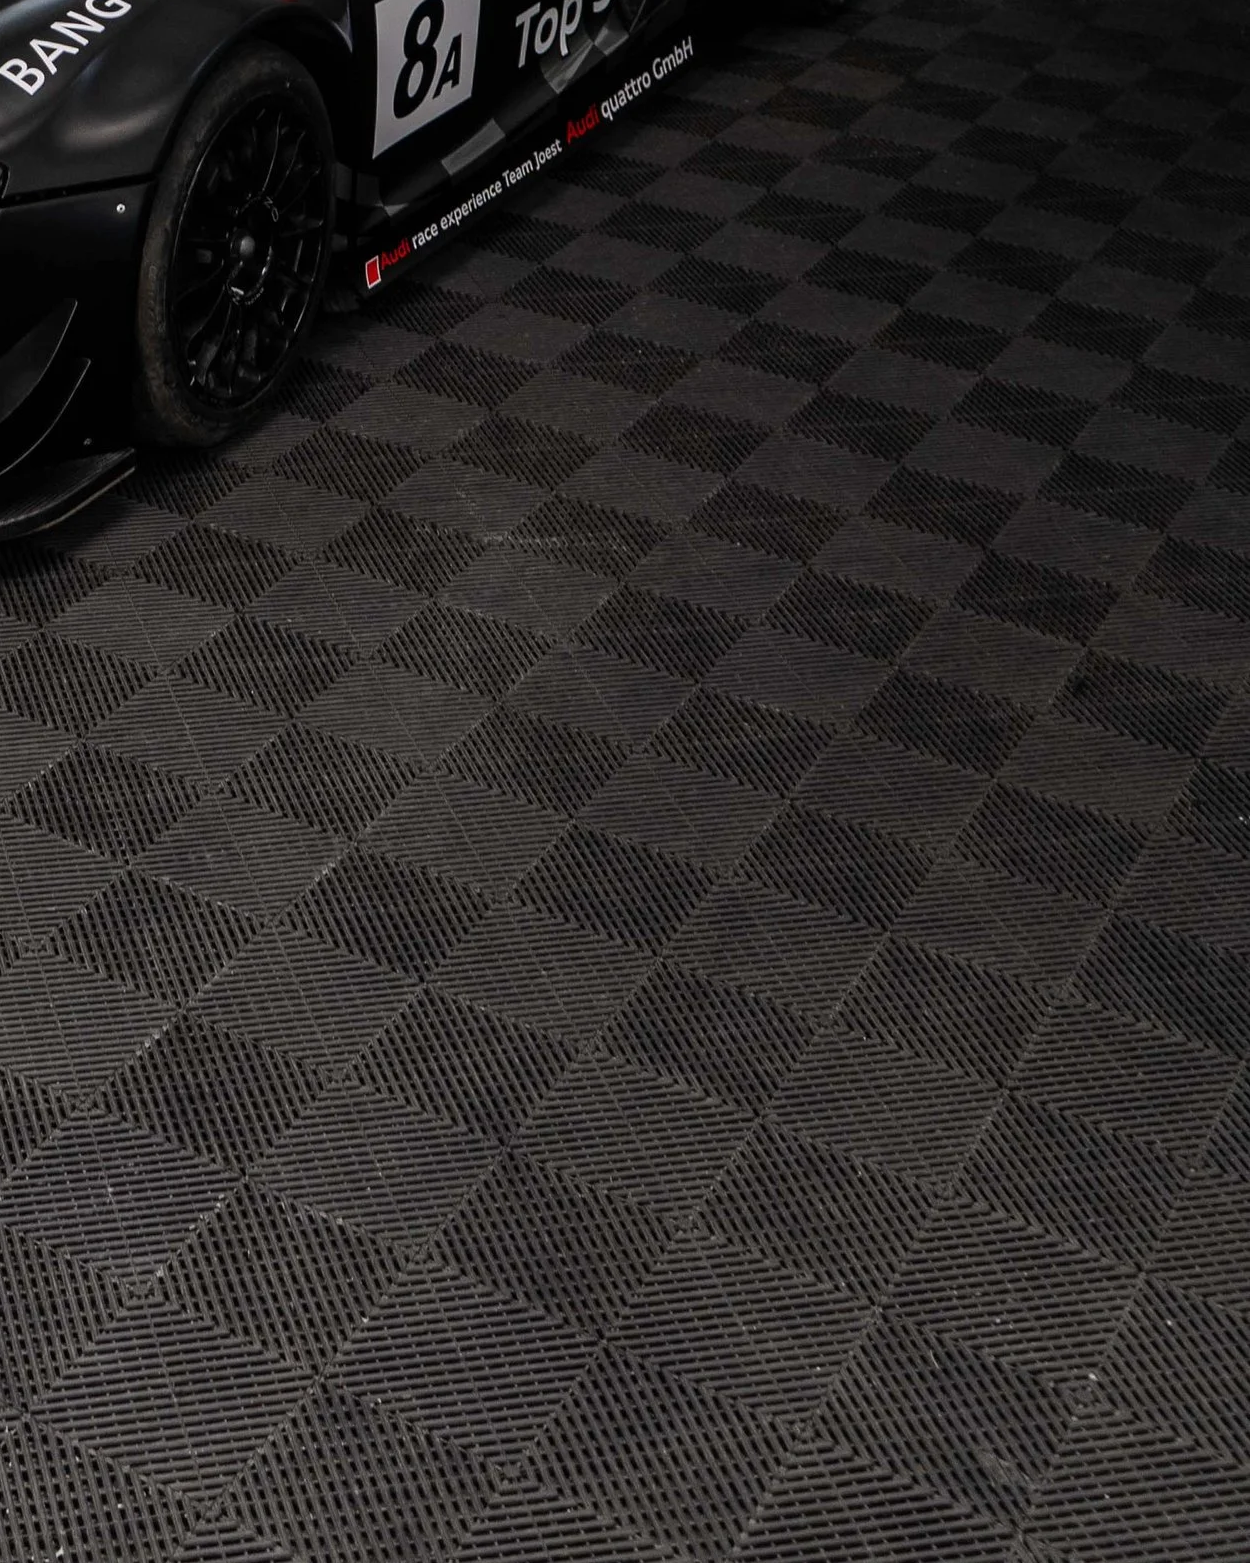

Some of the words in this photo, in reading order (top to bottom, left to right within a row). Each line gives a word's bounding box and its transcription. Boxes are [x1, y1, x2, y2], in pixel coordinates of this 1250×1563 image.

[380, 237, 411, 270] Audi
[411, 223, 439, 250] race
[440, 180, 503, 227] experience
[501, 159, 534, 188] Team
[532, 138, 563, 171] Joest
[566, 103, 600, 145] Audi
[600, 71, 651, 121] quattro
[652, 35, 694, 80] GmbH
